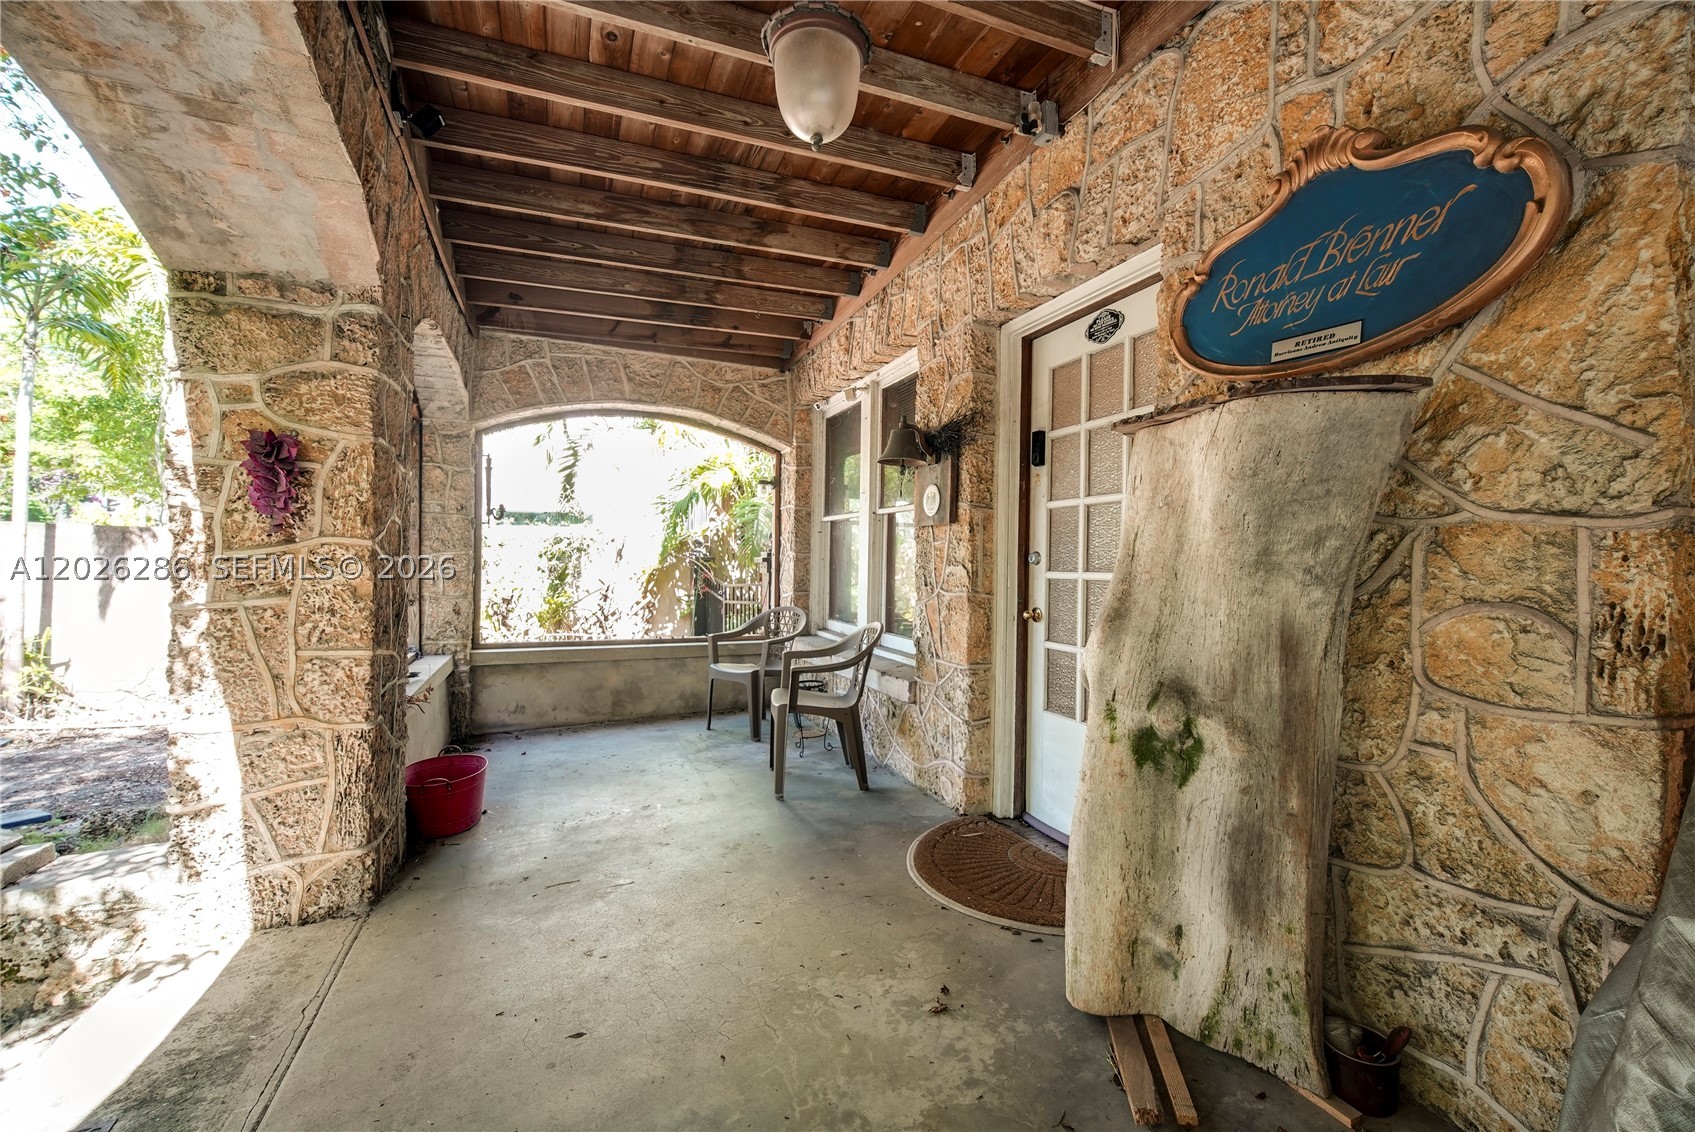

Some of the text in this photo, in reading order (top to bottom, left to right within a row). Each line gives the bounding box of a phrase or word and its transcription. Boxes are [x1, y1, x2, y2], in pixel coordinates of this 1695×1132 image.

[1212, 184, 1478, 313] Ronald Brenner
[1230, 252, 1422, 337] Attorney at Law
[1274, 335, 1358, 357] Hurricane Andrew Antiquity
[1294, 333, 1336, 348] RETIRED
